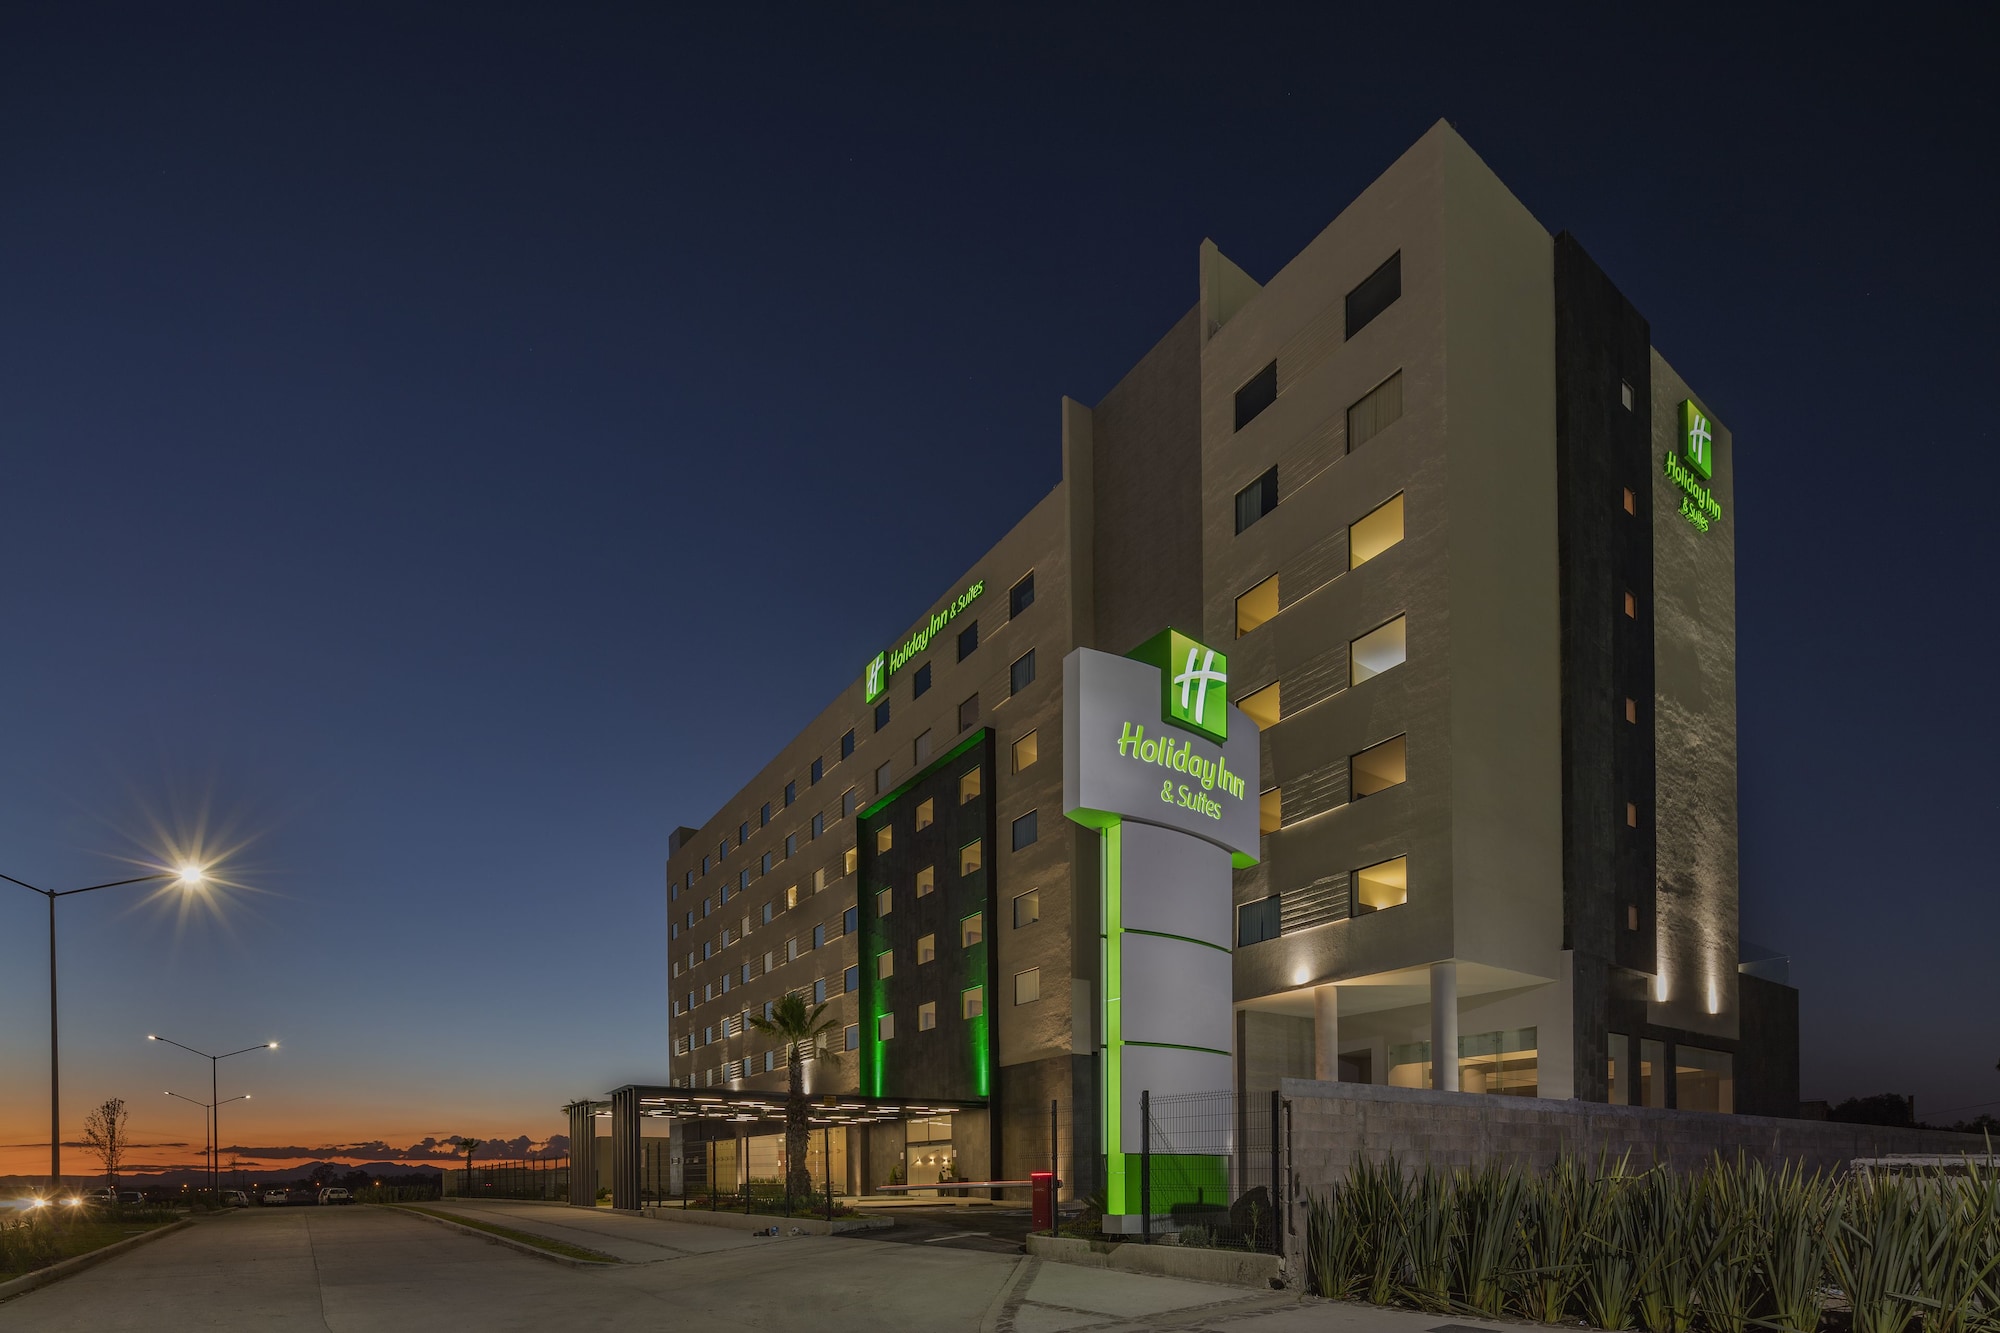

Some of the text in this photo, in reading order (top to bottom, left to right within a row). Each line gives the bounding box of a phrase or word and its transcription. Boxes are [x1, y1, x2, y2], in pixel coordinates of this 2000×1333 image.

[1666, 450, 1721, 521] Holiday Inn
[1680, 496, 1709, 532] & Suites
[889, 580, 983, 676] Holiday Inn & Suites
[1117, 721, 1246, 801] Holiday Inn
[1160, 779, 1223, 820] & Suites
